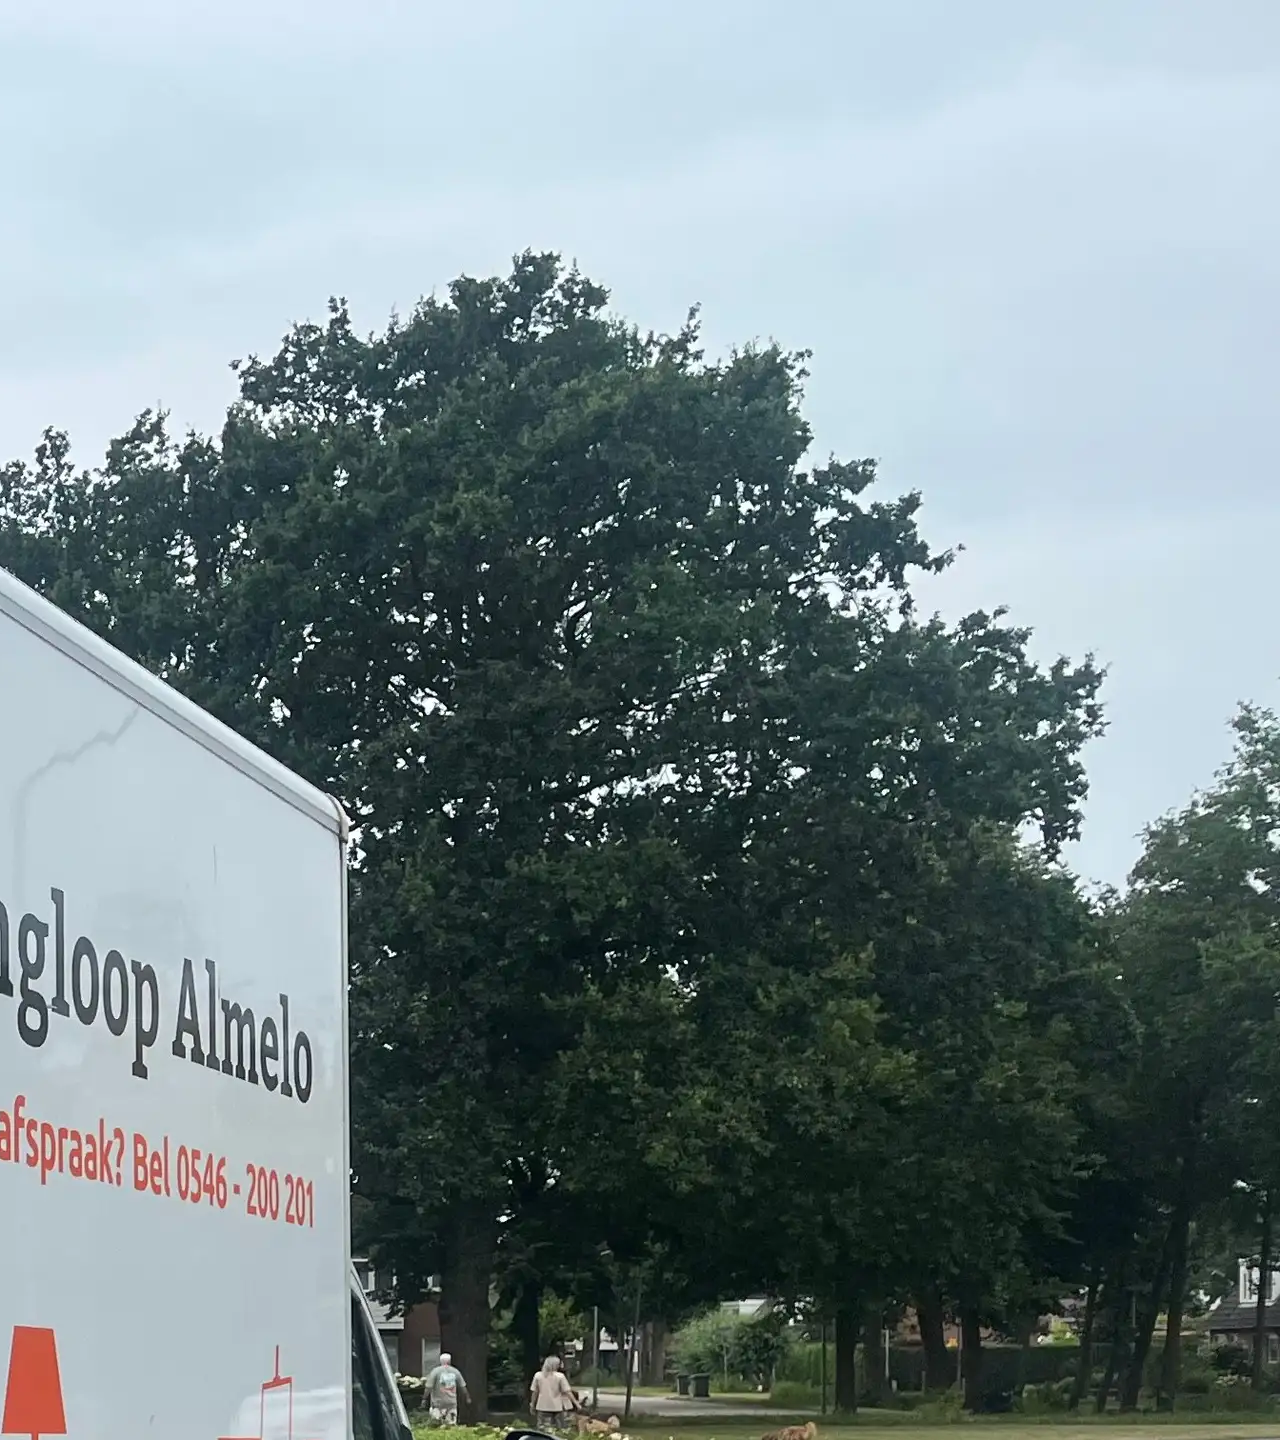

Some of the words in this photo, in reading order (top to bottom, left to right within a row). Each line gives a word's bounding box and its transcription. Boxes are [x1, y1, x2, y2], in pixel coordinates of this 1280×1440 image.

[172, 957, 314, 1104] Almelo
[133, 1132, 171, 1197] Bel
[177, 1144, 227, 1209] 0546
[246, 1163, 279, 1221] 200
[284, 1173, 314, 1228] 201
